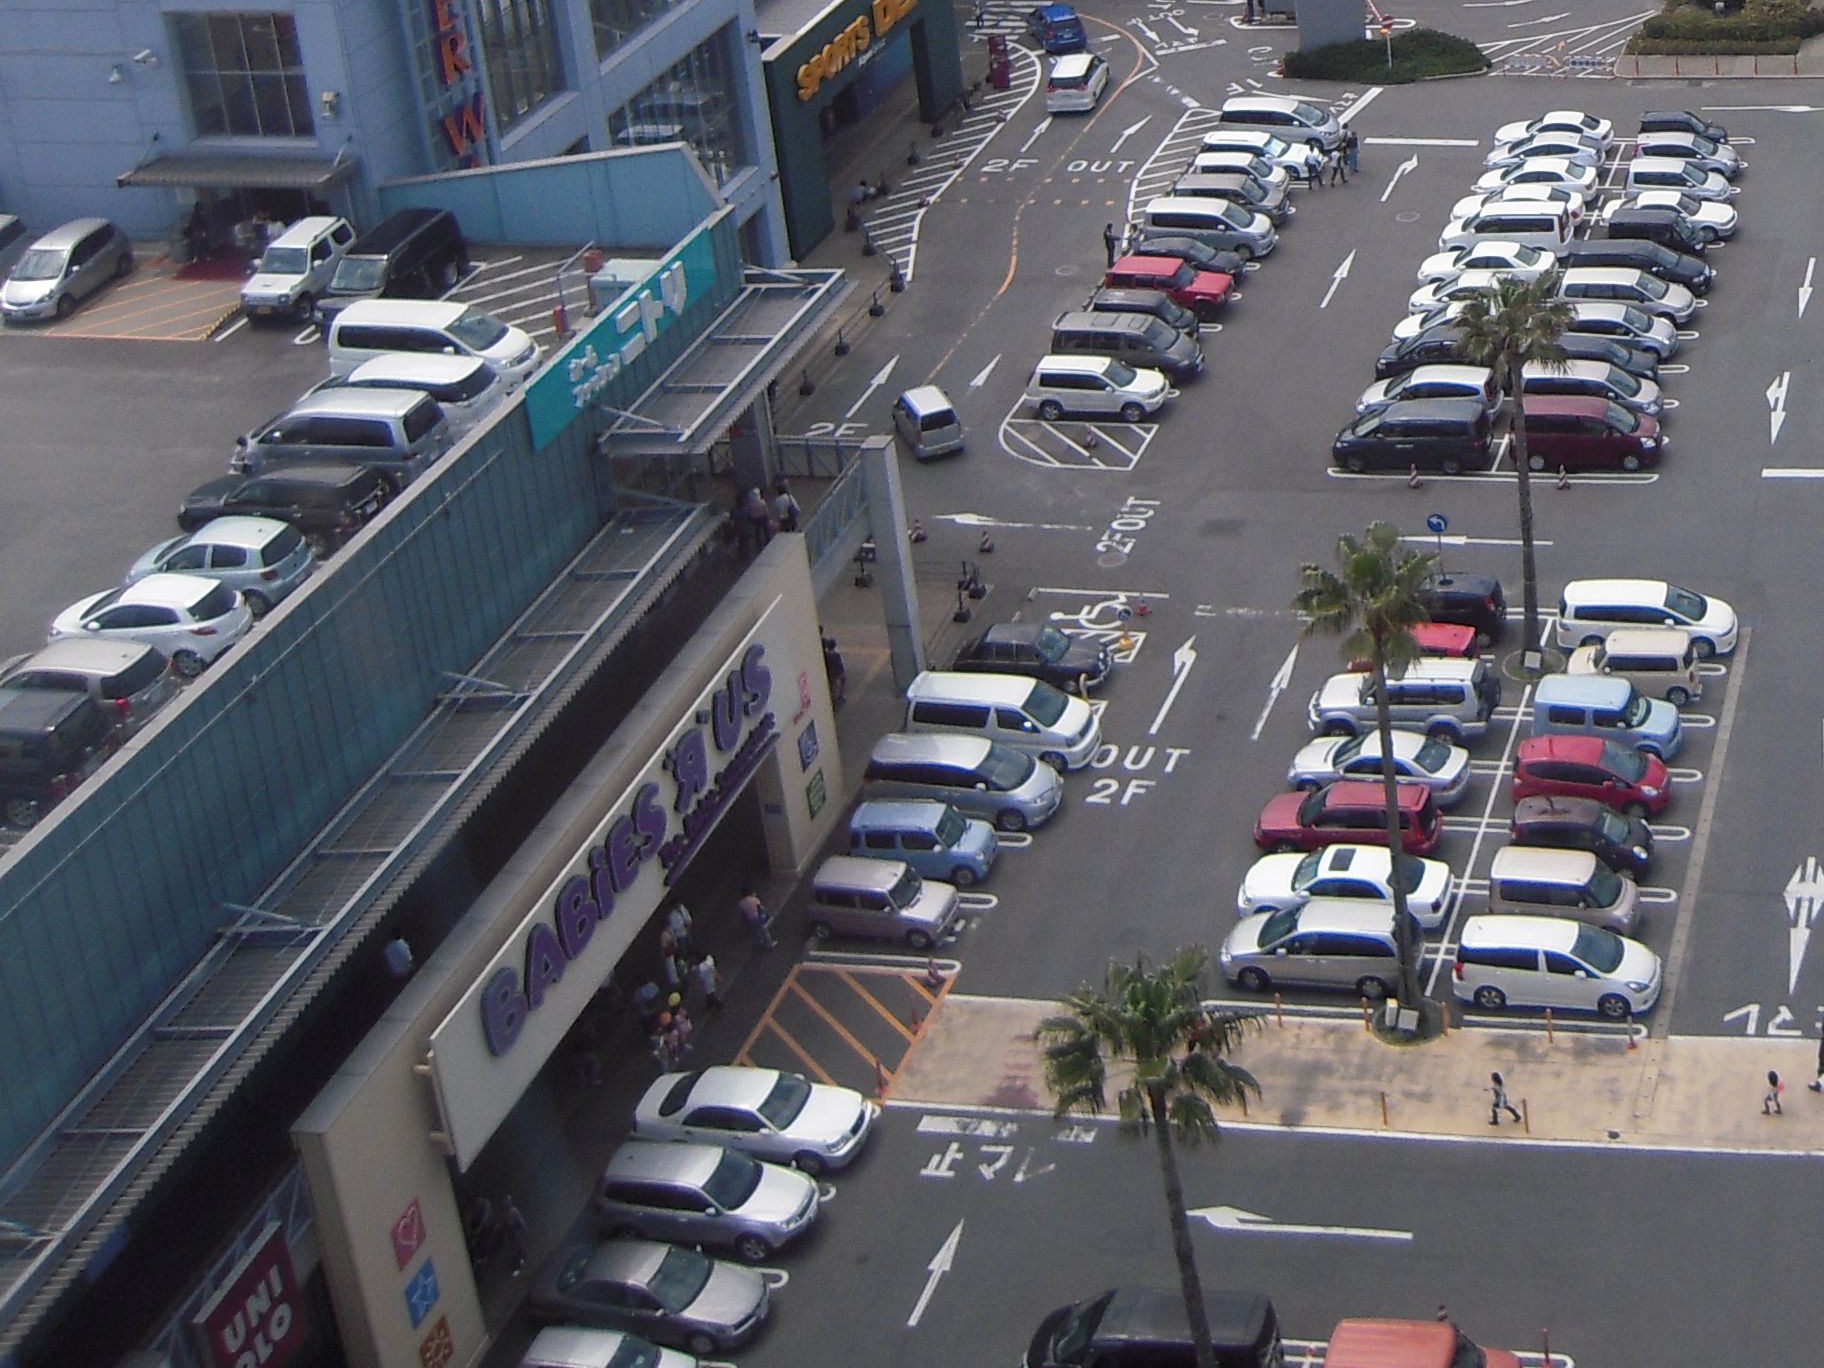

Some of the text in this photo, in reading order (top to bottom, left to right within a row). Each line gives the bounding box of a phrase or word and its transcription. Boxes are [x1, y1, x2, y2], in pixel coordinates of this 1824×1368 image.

[797, 15, 871, 102] SPORTS
[980, 158, 1135, 173] 2F OUT
[615, 260, 687, 365] ニトリ
[804, 422, 869, 439] 2F
[712, 643, 774, 752] US
[1090, 743, 1191, 773] OUT
[1085, 778, 1156, 805] 2F
[224, 1264, 283, 1353] UNI
